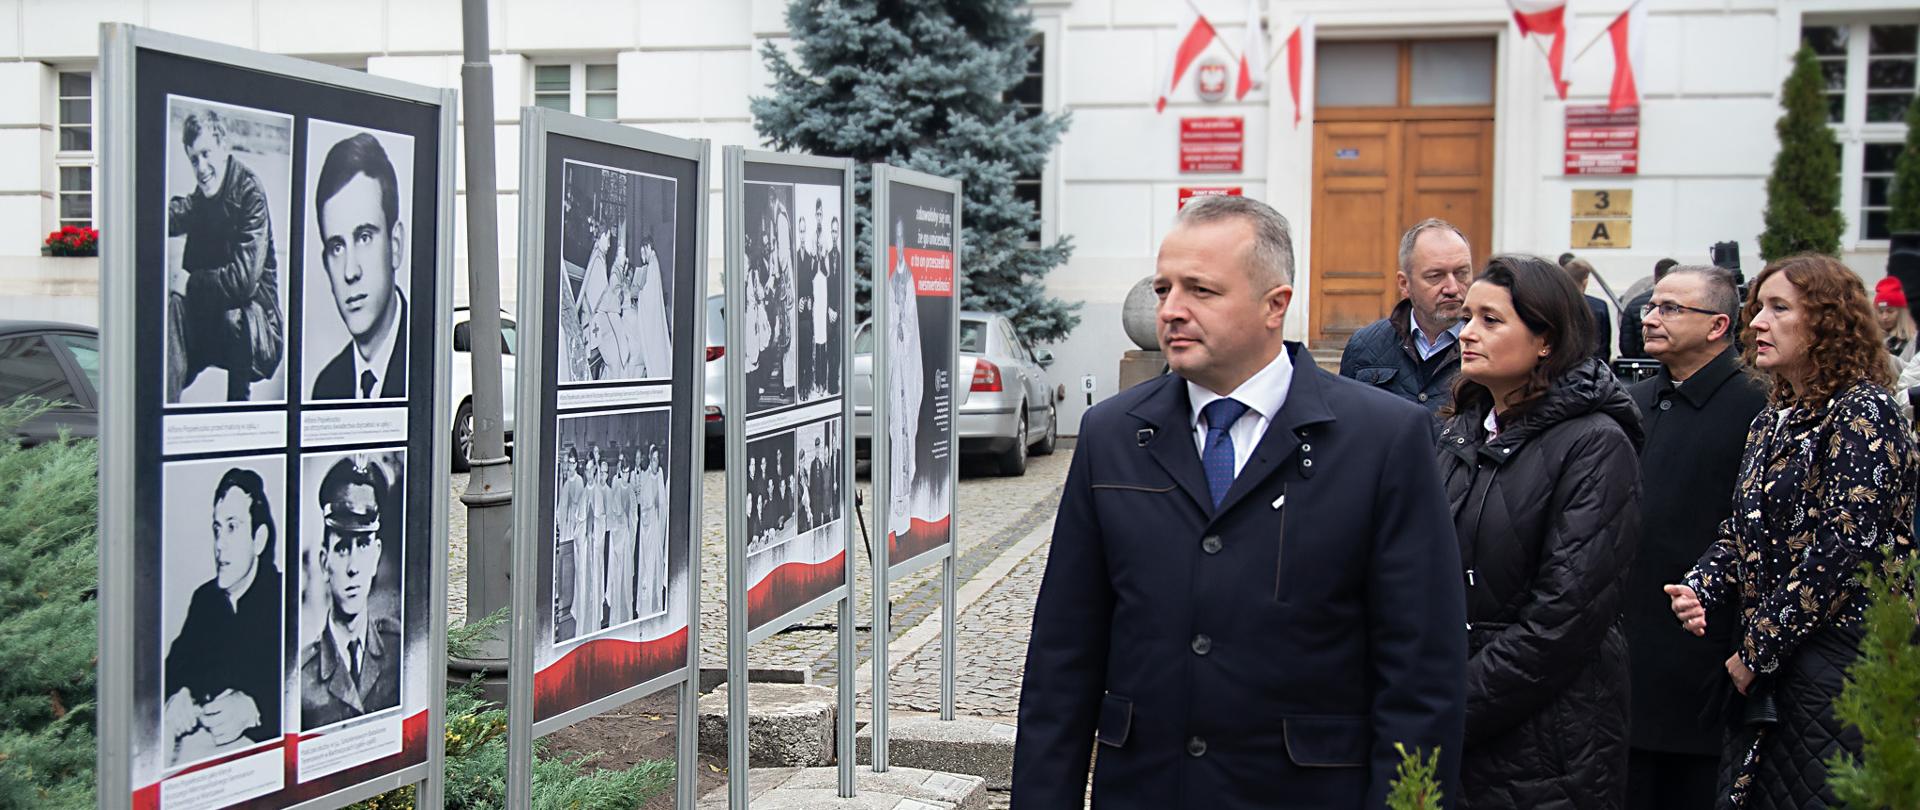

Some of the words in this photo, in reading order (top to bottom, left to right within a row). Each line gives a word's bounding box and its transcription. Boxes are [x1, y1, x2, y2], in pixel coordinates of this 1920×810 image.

[1594, 190, 1609, 210] 3
[1591, 222, 1610, 240] A
[1086, 378, 1092, 389] 6
